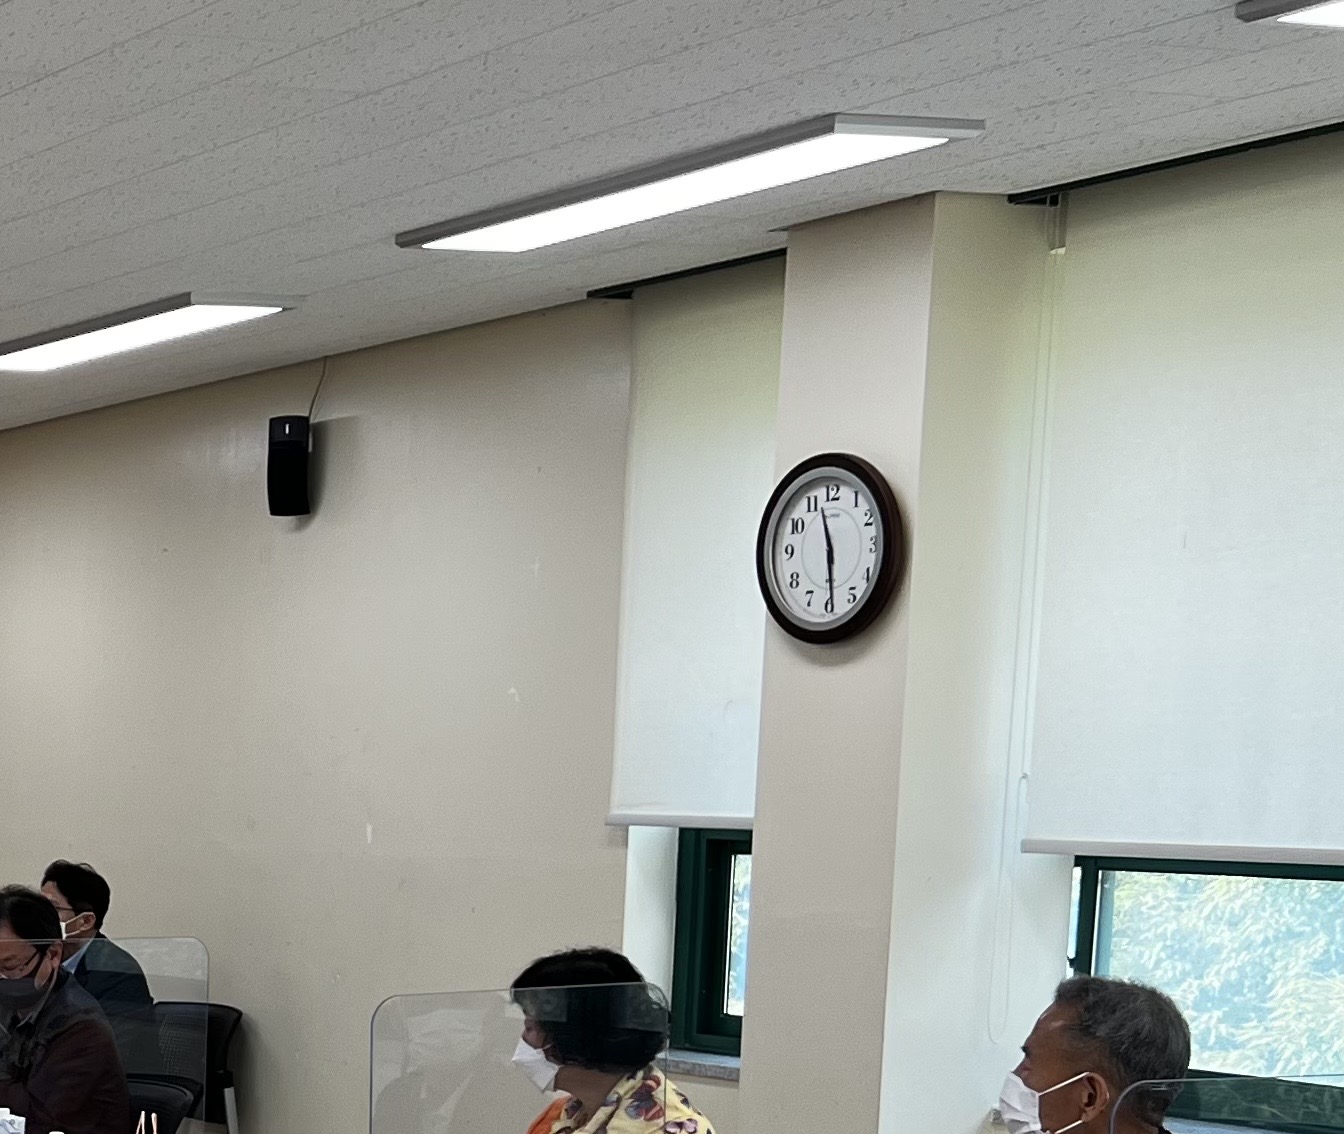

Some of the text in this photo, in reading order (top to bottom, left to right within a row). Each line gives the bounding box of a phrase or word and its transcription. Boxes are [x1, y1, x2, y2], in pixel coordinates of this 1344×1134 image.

[825, 484, 841, 502] 12
[853, 490, 859, 508] 1
[805, 495, 819, 513] 11
[790, 518, 805, 535] 10
[864, 509, 874, 527] 2
[784, 544, 794, 561] 9
[869, 535, 877, 554] 3
[789, 572, 800, 589] 8
[805, 590, 814, 607] 7
[847, 586, 857, 604] 5
[824, 597, 834, 614] 6
